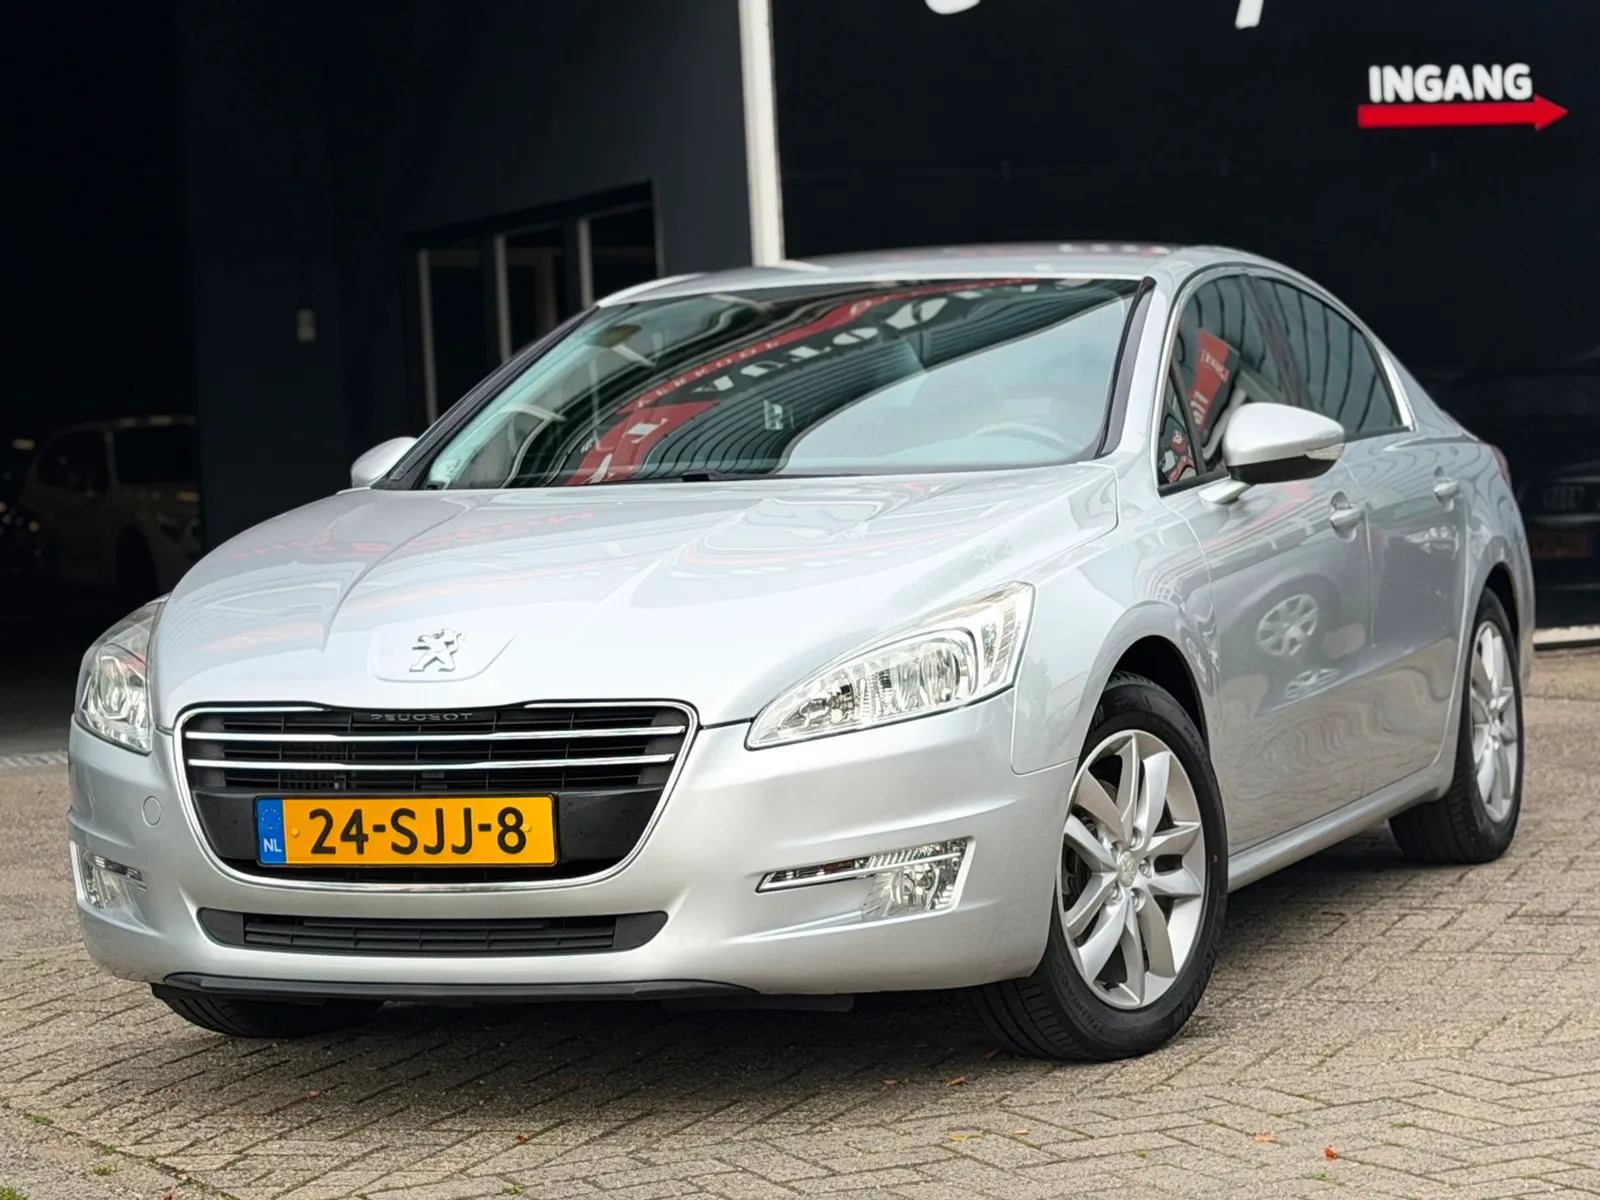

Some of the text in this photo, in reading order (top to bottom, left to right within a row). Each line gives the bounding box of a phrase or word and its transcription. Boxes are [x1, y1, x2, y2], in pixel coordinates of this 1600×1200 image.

[1368, 63, 1533, 103] INGANG
[370, 712, 474, 722] PEUGEOT
[309, 806, 527, 855] 24-SJJ-8
[263, 838, 283, 853] NL
